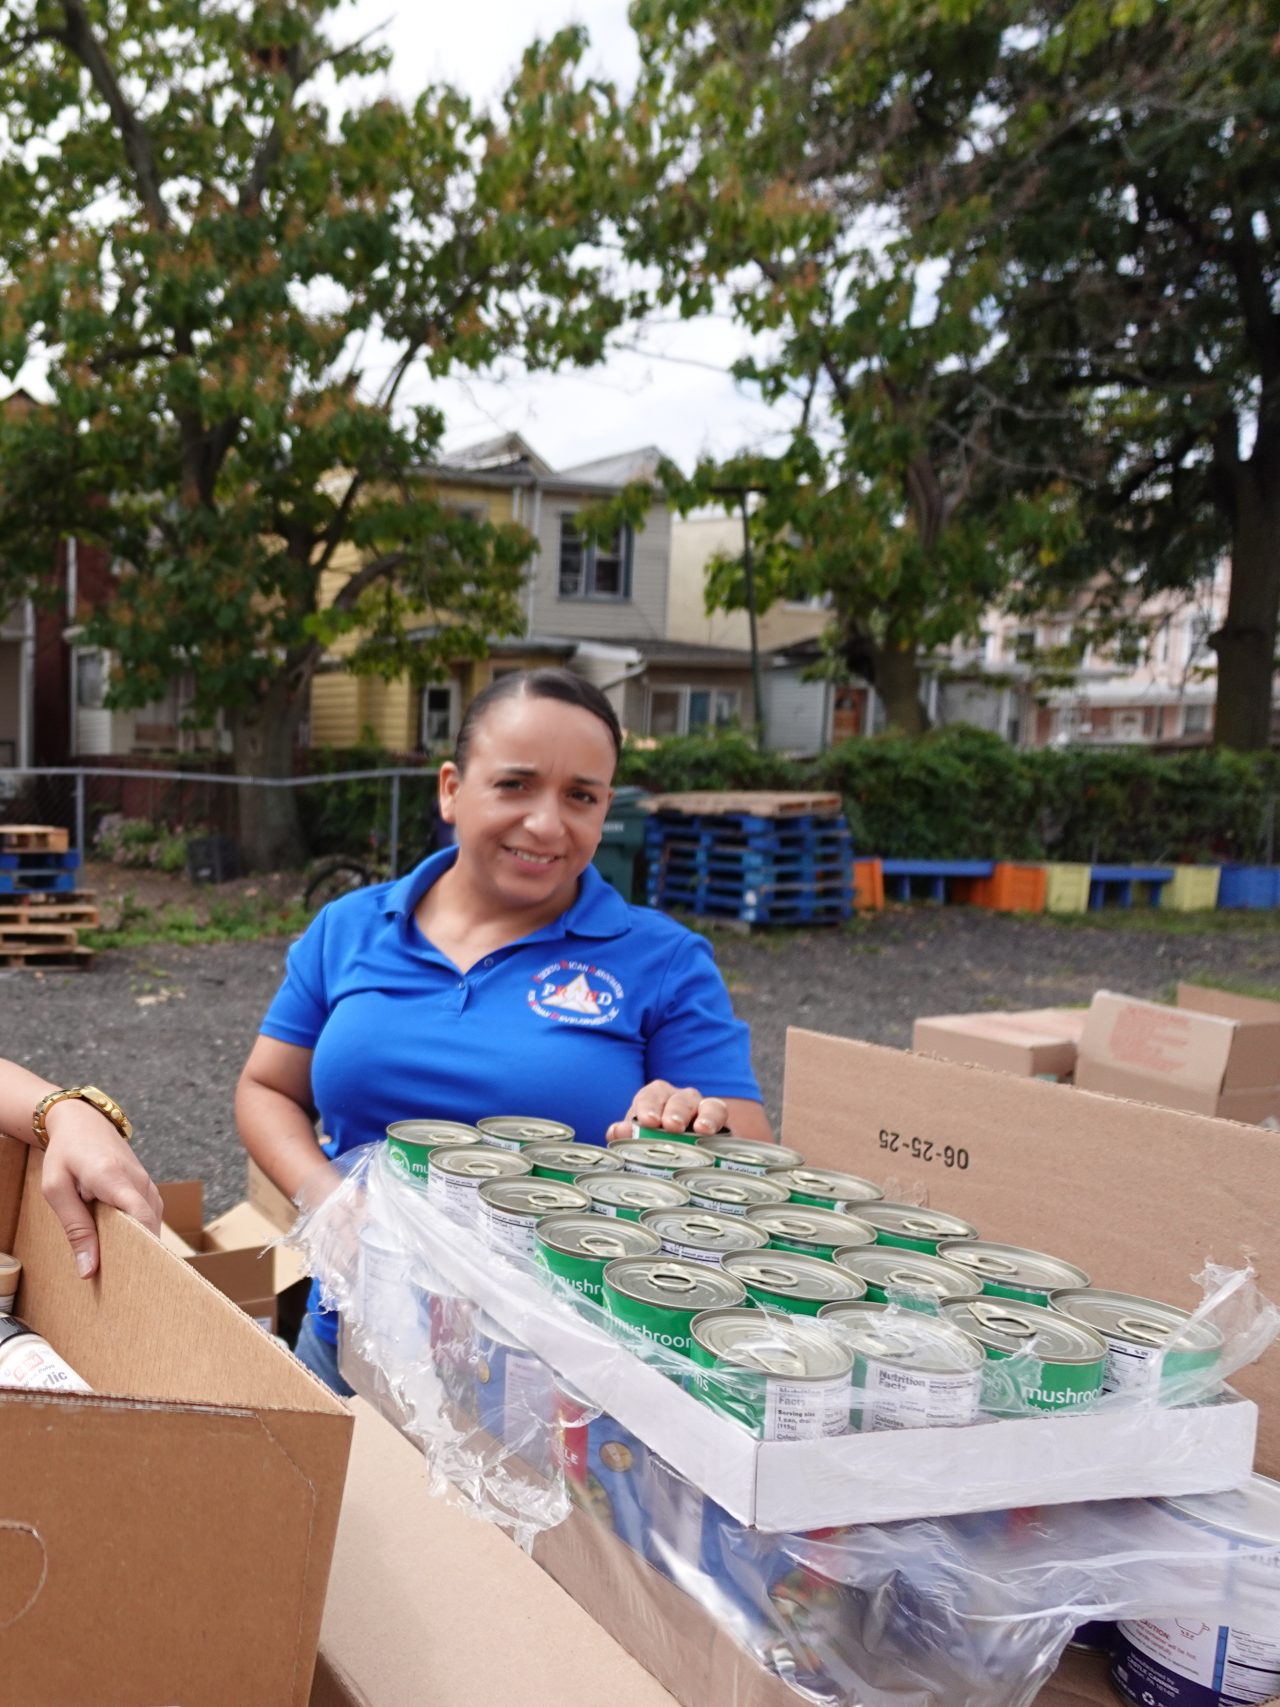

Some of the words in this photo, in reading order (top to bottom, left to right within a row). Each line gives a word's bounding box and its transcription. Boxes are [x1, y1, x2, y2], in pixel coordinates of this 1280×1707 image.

[879, 1129, 969, 1170] 06-25-25
[878, 1380, 908, 1392] Facts
[879, 1369, 925, 1387] Nutrition
